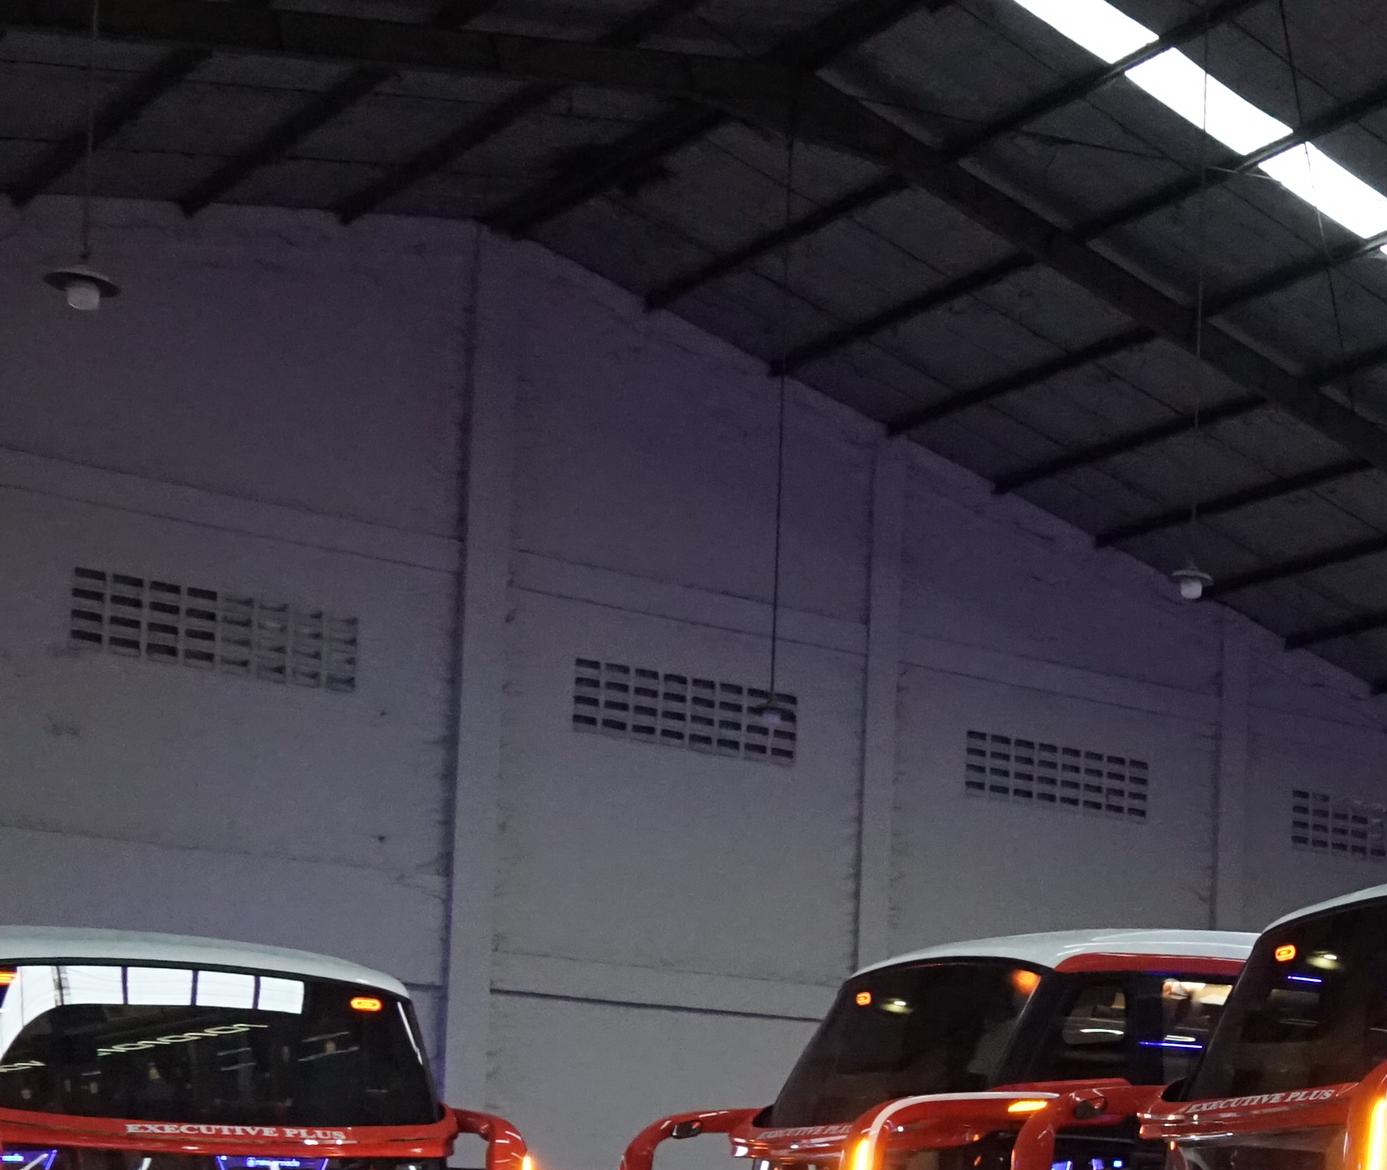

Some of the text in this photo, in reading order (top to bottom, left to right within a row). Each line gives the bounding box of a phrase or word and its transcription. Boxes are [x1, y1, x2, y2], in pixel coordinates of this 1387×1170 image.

[1185, 1089, 1335, 1113] EXECUTIVE PLUS
[125, 1123, 347, 1141] EXECUTIVE PLUS
